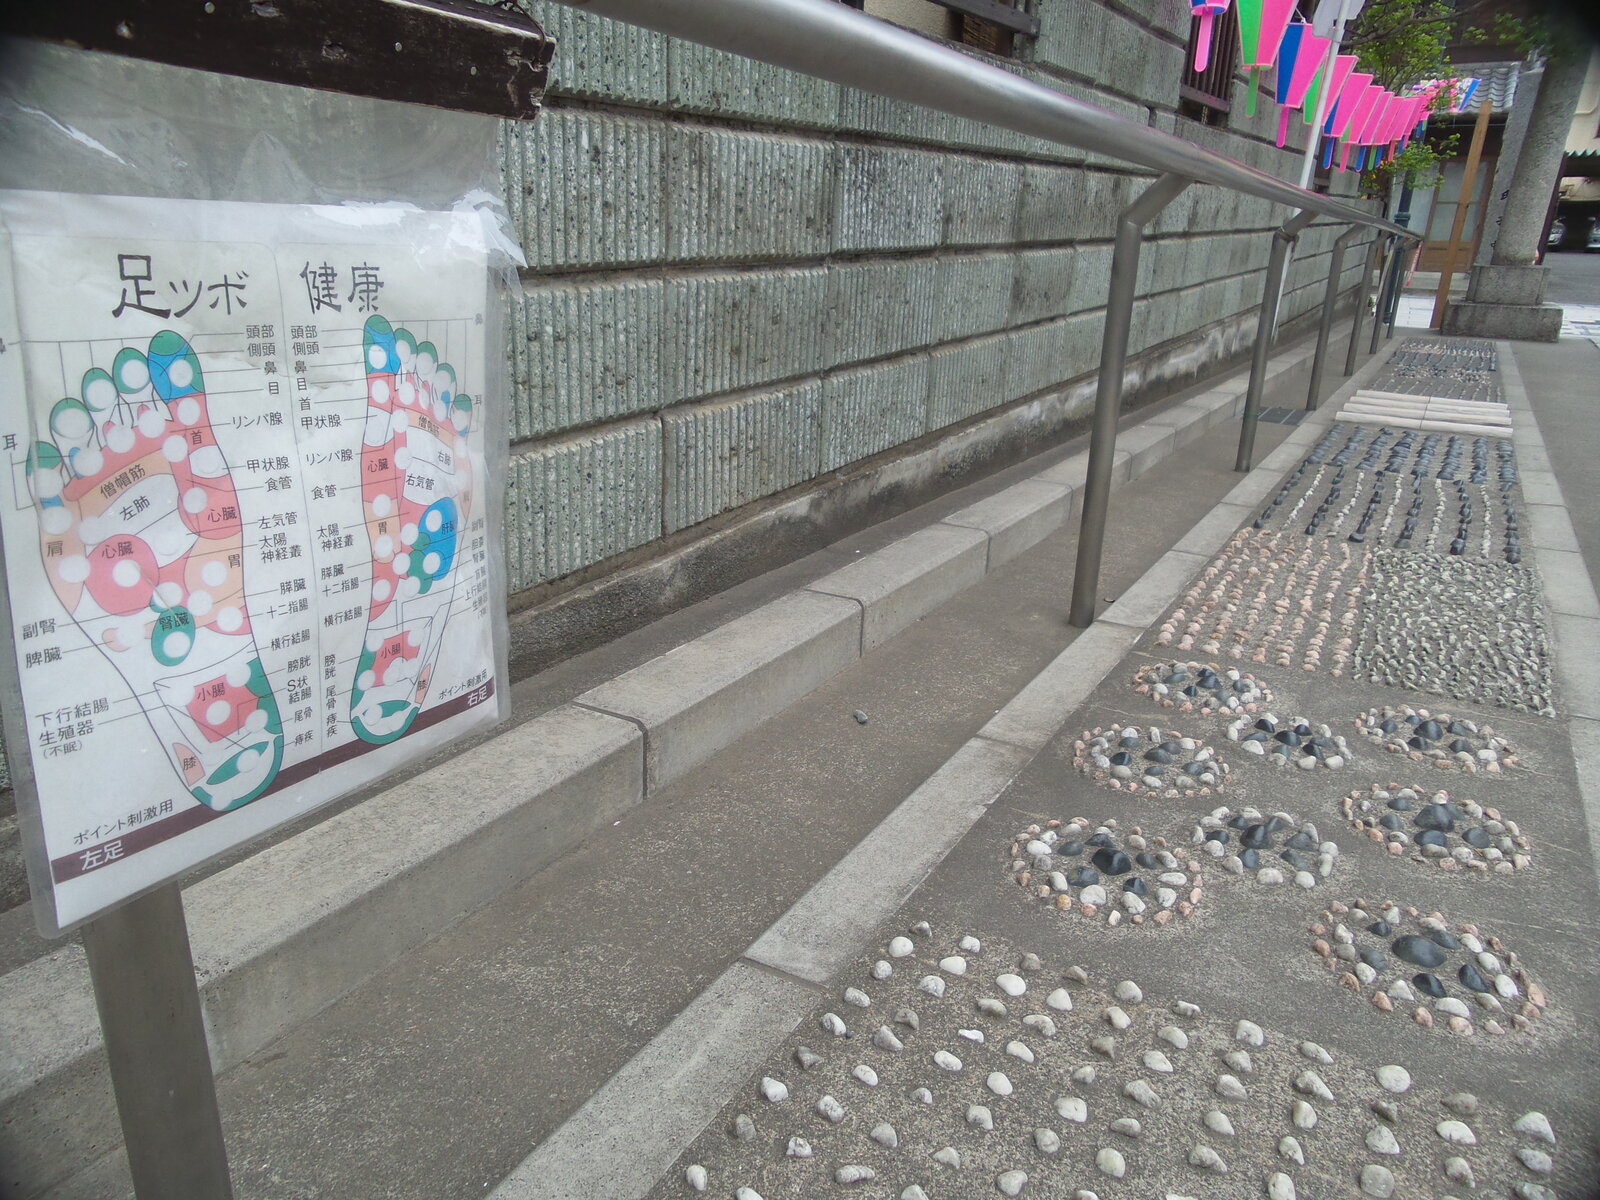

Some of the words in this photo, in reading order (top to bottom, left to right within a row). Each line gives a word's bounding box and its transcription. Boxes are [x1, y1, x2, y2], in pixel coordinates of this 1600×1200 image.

[112, 254, 249, 319] 足ツボ
[300, 261, 384, 314] 健康
[246, 324, 275, 339] 頭部
[290, 325, 318, 339] 頭部
[247, 342, 276, 357] 側頭
[292, 341, 320, 356] 側頭
[264, 361, 278, 375] 鼻
[294, 360, 307, 374] 鼻
[268, 381, 279, 395] 目
[297, 377, 307, 391] 目
[298, 396, 311, 411] 首
[232, 411, 283, 429] リンパ腺
[301, 414, 342, 430] 甲状腺
[2, 433, 18, 450] 耳
[190, 430, 202, 445] 首
[247, 456, 290, 473] 甲状腺
[306, 448, 353, 466] リンパ腺
[368, 458, 389, 473] 心臓
[100, 464, 146, 499] 僧帽筋
[265, 475, 293, 492] 食管
[405, 473, 435, 491] 右気管
[311, 484, 337, 500] 食管
[119, 495, 150, 521] 左肺
[207, 506, 238, 523] 心臓
[258, 511, 298, 529] 左気管
[378, 521, 388, 535] 胃
[316, 523, 340, 540] 太陽
[47, 541, 63, 558] 肩
[101, 541, 134, 559] 心臓
[259, 532, 288, 550] 太陽
[321, 534, 354, 552] 神経叢
[228, 553, 240, 569] 胃
[260, 544, 302, 564] 神経叢
[280, 577, 307, 595] 膵臓
[322, 577, 359, 597] 十二指腸
[266, 597, 309, 619] 十二指腸
[324, 605, 363, 628] 横行結腸
[22, 618, 57, 640] 副腎
[159, 612, 190, 631] 腎臓
[271, 628, 311, 651] 横行結腸
[26, 647, 63, 669] 脾臓
[381, 643, 401, 659] 小腸
[287, 655, 312, 673] 膀胱
[197, 682, 226, 701] 小腸
[287, 675, 308, 692] S状
[439, 668, 488, 700] ポイント刺激用
[288, 686, 312, 705] 結腸
[467, 685, 488, 706] 右足
[35, 697, 110, 728] 下行結腸
[294, 706, 313, 723] 尾骨
[39, 719, 95, 747] 生殖器
[43, 739, 83, 760] (不眠)
[183, 757, 197, 771] 膝
[74, 799, 174, 845] ポイント刺激用
[80, 840, 124, 870] 左足
